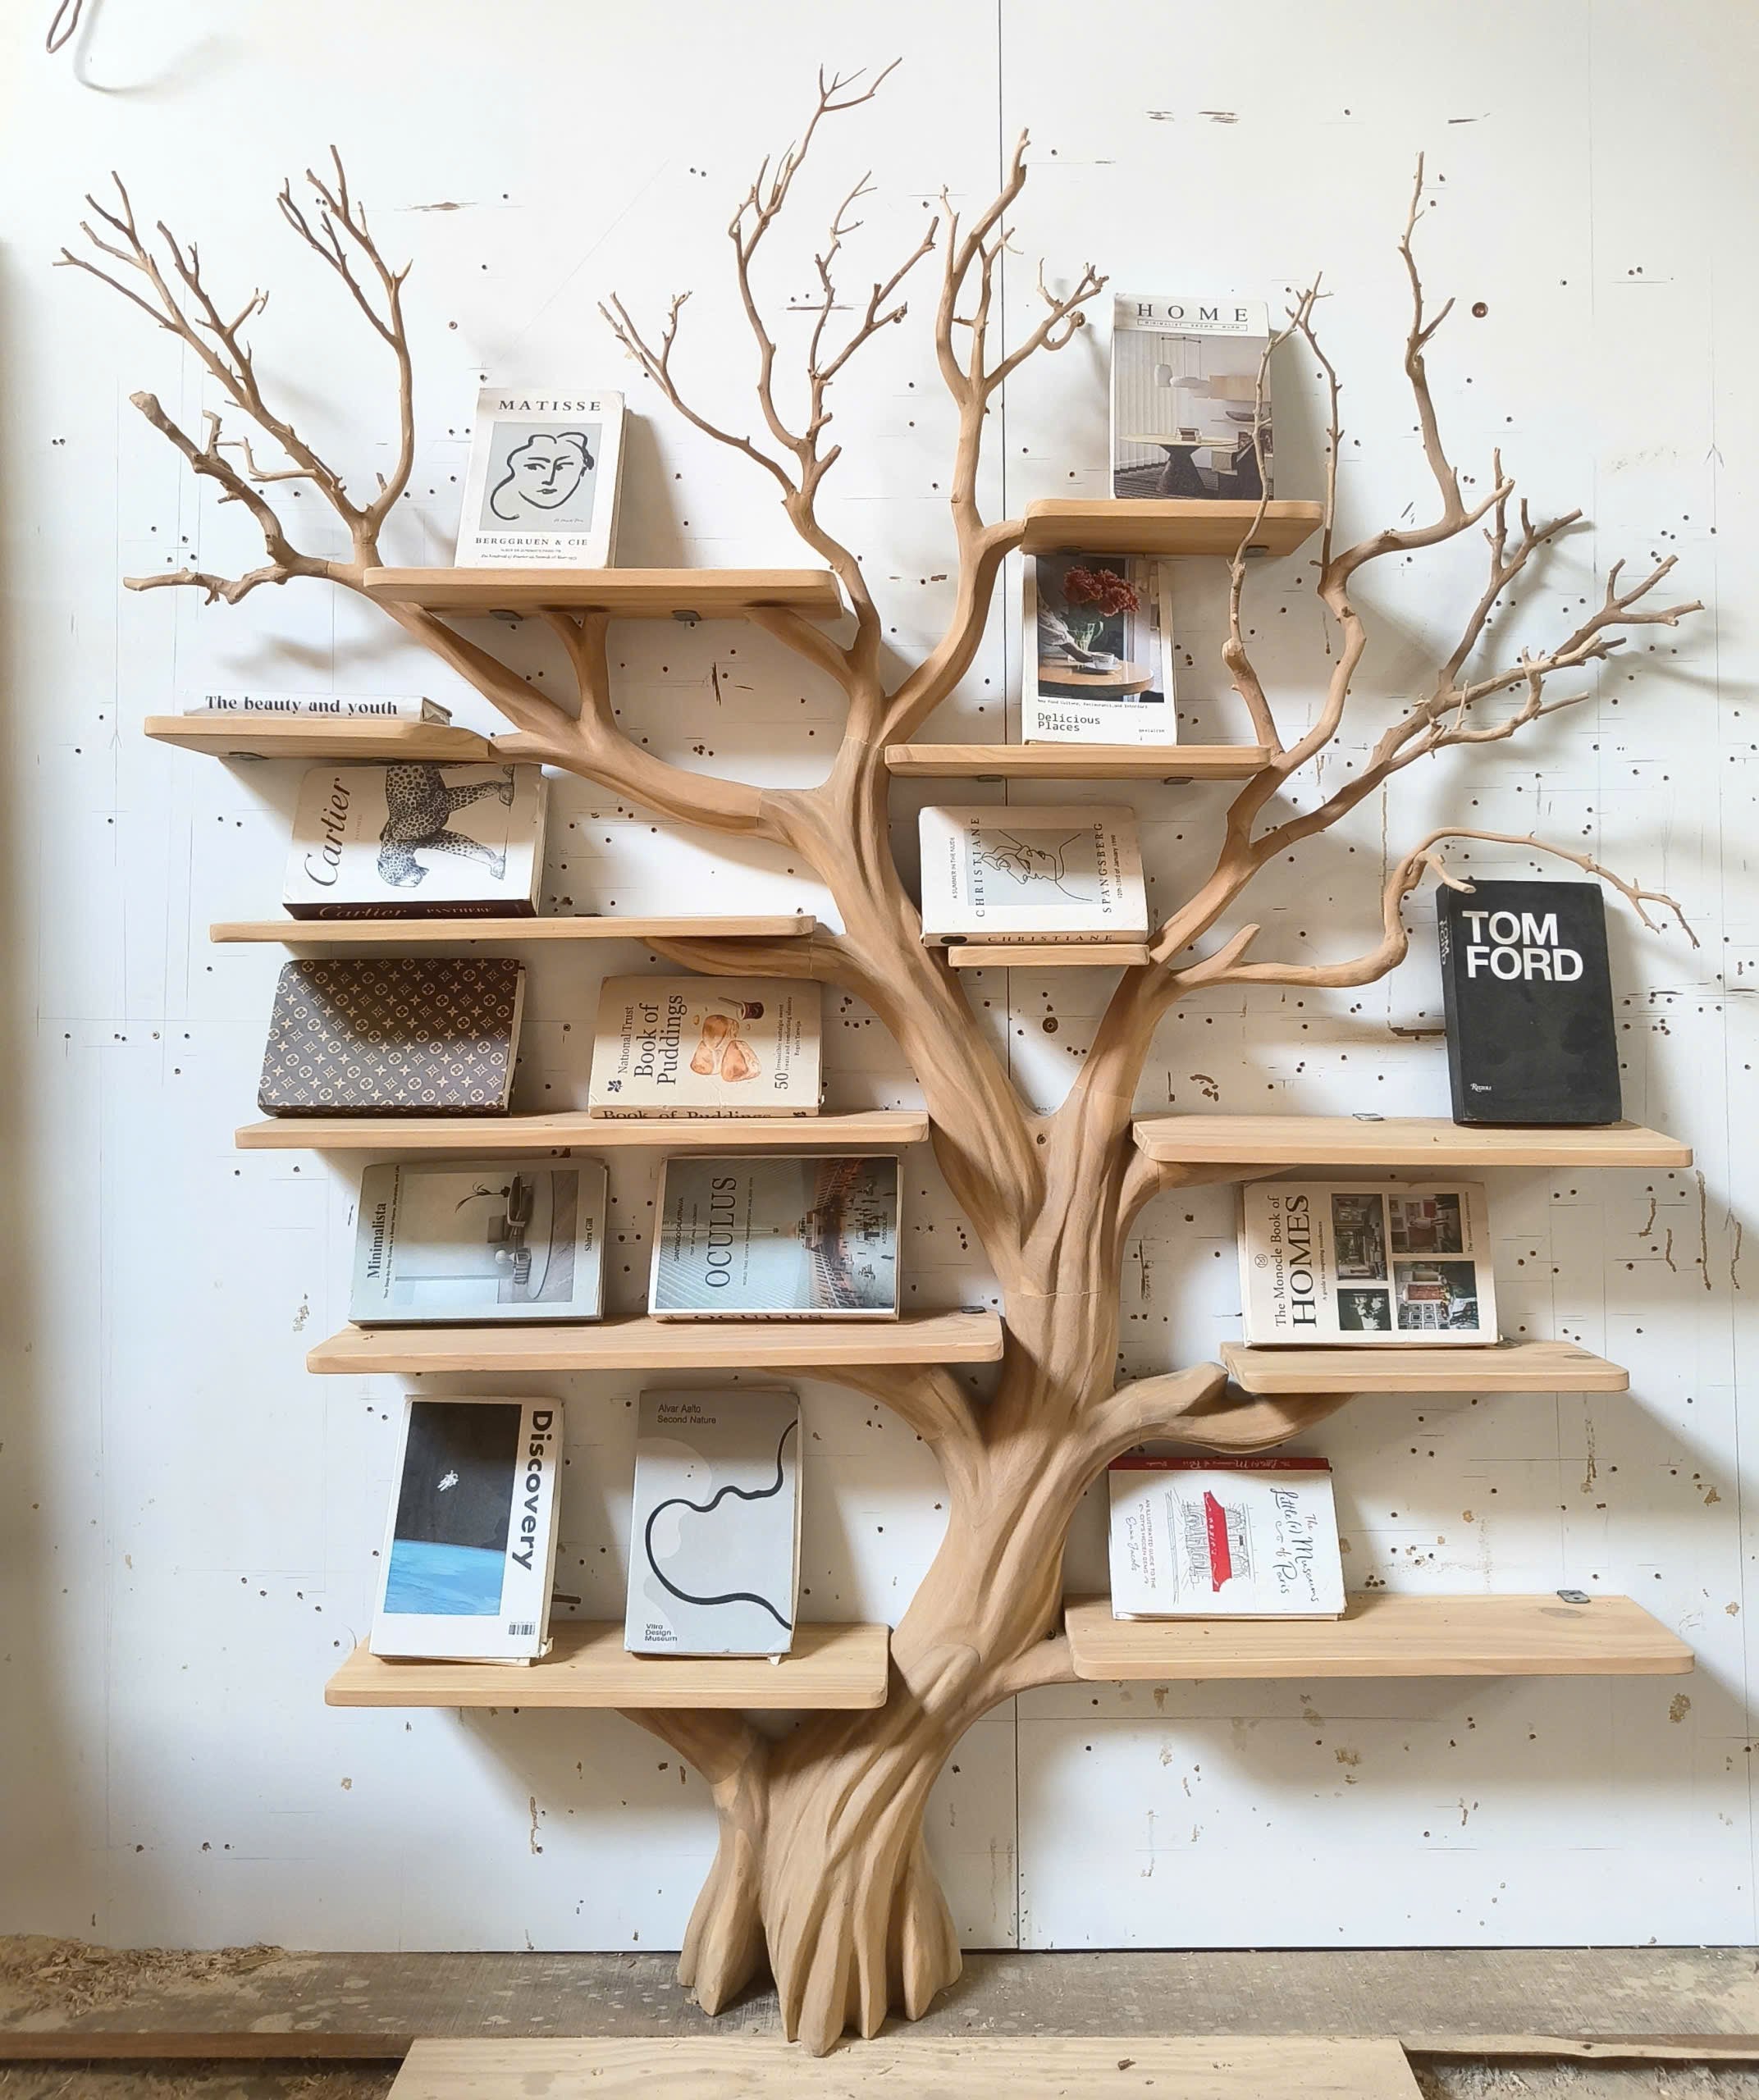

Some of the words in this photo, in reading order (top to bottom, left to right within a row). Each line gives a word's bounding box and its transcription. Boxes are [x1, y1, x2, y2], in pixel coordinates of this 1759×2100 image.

[1137, 304, 1248, 322] HOME
[498, 399, 601, 411] MATISSE
[205, 696, 237, 710] The
[244, 696, 301, 714] beauty
[308, 699, 340, 713] and
[348, 701, 398, 715] youth
[1038, 712, 1100, 724] Delicious
[1038, 721, 1080, 731] Places
[304, 777, 352, 887] Cartier
[971, 818, 985, 917] CHRISTIANE
[1094, 822, 1112, 913] SPANGSBERG
[319, 905, 407, 917] Cartier
[1462, 911, 1559, 946] TOM
[1466, 945, 1583, 982] FORD
[621, 1006, 634, 1030] Trust
[639, 1002, 659, 1023] of
[618, 1031, 632, 1075] National
[633, 1029, 657, 1078] Book
[656, 994, 688, 1085] Puddings
[774, 1073, 788, 1089] 50
[1268, 1195, 1279, 1208] of
[367, 1203, 386, 1278] Minimalista
[706, 1177, 737, 1287] OCULUS
[1268, 1214, 1282, 1244] Book
[674, 1232, 682, 1262] SANTIAGO
[1286, 1194, 1318, 1328] HOMES
[1271, 1248, 1285, 1299] Monocle
[1275, 1303, 1286, 1327] The
[657, 1415, 688, 1424] Second
[690, 1416, 716, 1424] Nature
[658, 1404, 679, 1413] Alvar
[681, 1404, 701, 1413] Aalto
[512, 1411, 553, 1571] Discovery
[1145, 1499, 1150, 1508] AN
[1150, 1568, 1155, 1576] TO
[1304, 1513, 1318, 1532] The
[1275, 1547, 1292, 1559] of
[1272, 1561, 1298, 1595] Paris
[1291, 1536, 1319, 1603] Museums
